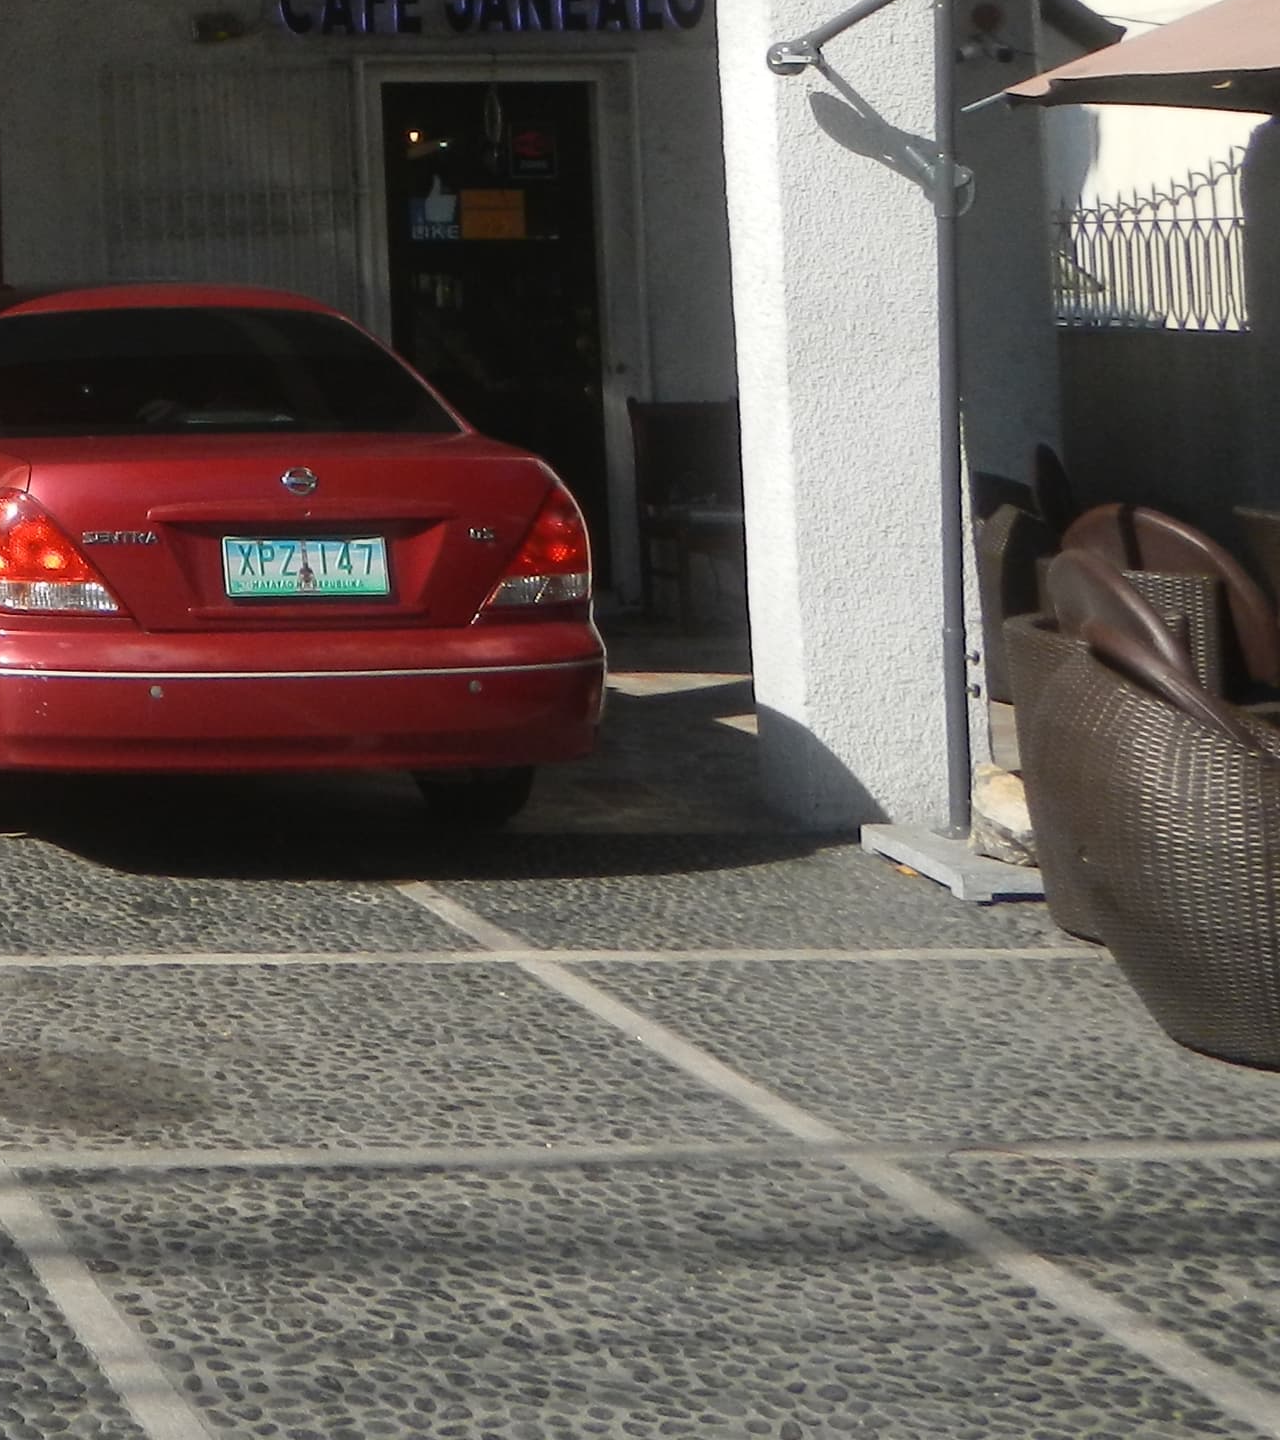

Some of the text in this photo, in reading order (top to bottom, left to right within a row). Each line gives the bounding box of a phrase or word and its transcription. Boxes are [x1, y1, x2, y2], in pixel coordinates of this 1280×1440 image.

[410, 224, 460, 240] LIKE
[81, 530, 158, 544] SENTRA
[238, 541, 373, 576] XPZ 147
